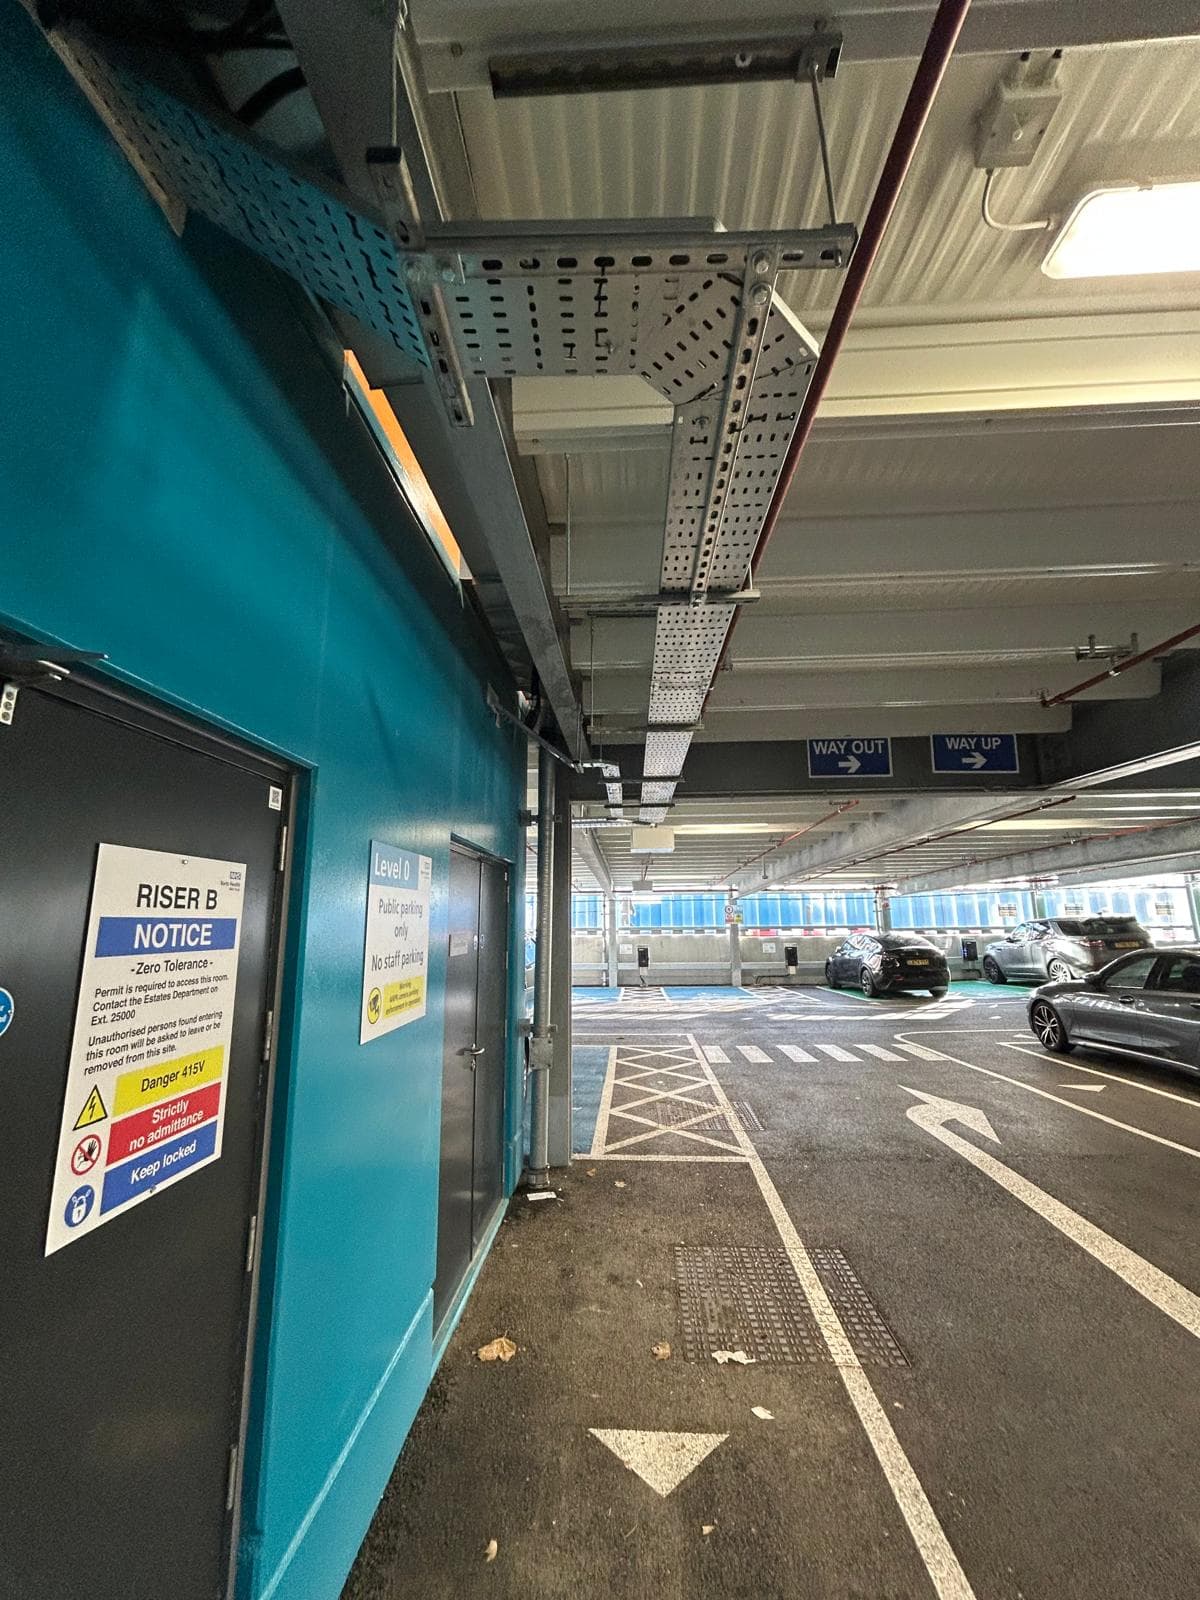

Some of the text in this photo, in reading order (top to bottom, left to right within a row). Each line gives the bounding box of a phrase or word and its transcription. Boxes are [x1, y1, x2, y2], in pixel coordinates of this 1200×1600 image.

[812, 740, 885, 755] WAY OUT
[945, 736, 1001, 750] WAY UP
[374, 852, 402, 879] Level
[404, 860, 410, 880] 0
[136, 883, 218, 910] RISER B
[379, 899, 423, 918] Public parking
[134, 923, 213, 949] NOTICE
[394, 922, 409, 940] only
[371, 948, 424, 972] No staff parking
[94, 986, 124, 998] Permit
[126, 984, 133, 994] is
[135, 981, 166, 995] required
[176, 979, 199, 987] access
[200, 975, 212, 983] this
[93, 999, 127, 1012] Contact
[129, 997, 142, 1007] the
[144, 993, 171, 1004] Estates
[172, 987, 209, 1000] Department
[88, 1010, 223, 1047] Unauthorised persons found entering
[91, 1009, 136, 1026] Ext. 25000
[86, 1021, 221, 1061] this room will be asked to leave or be
[84, 1044, 177, 1076] removed from this site.
[141, 1060, 206, 1092] Danger 415V
[152, 1100, 189, 1124] Strictly
[129, 1110, 204, 1152] no admittance
[130, 1140, 197, 1185] Keep locked
